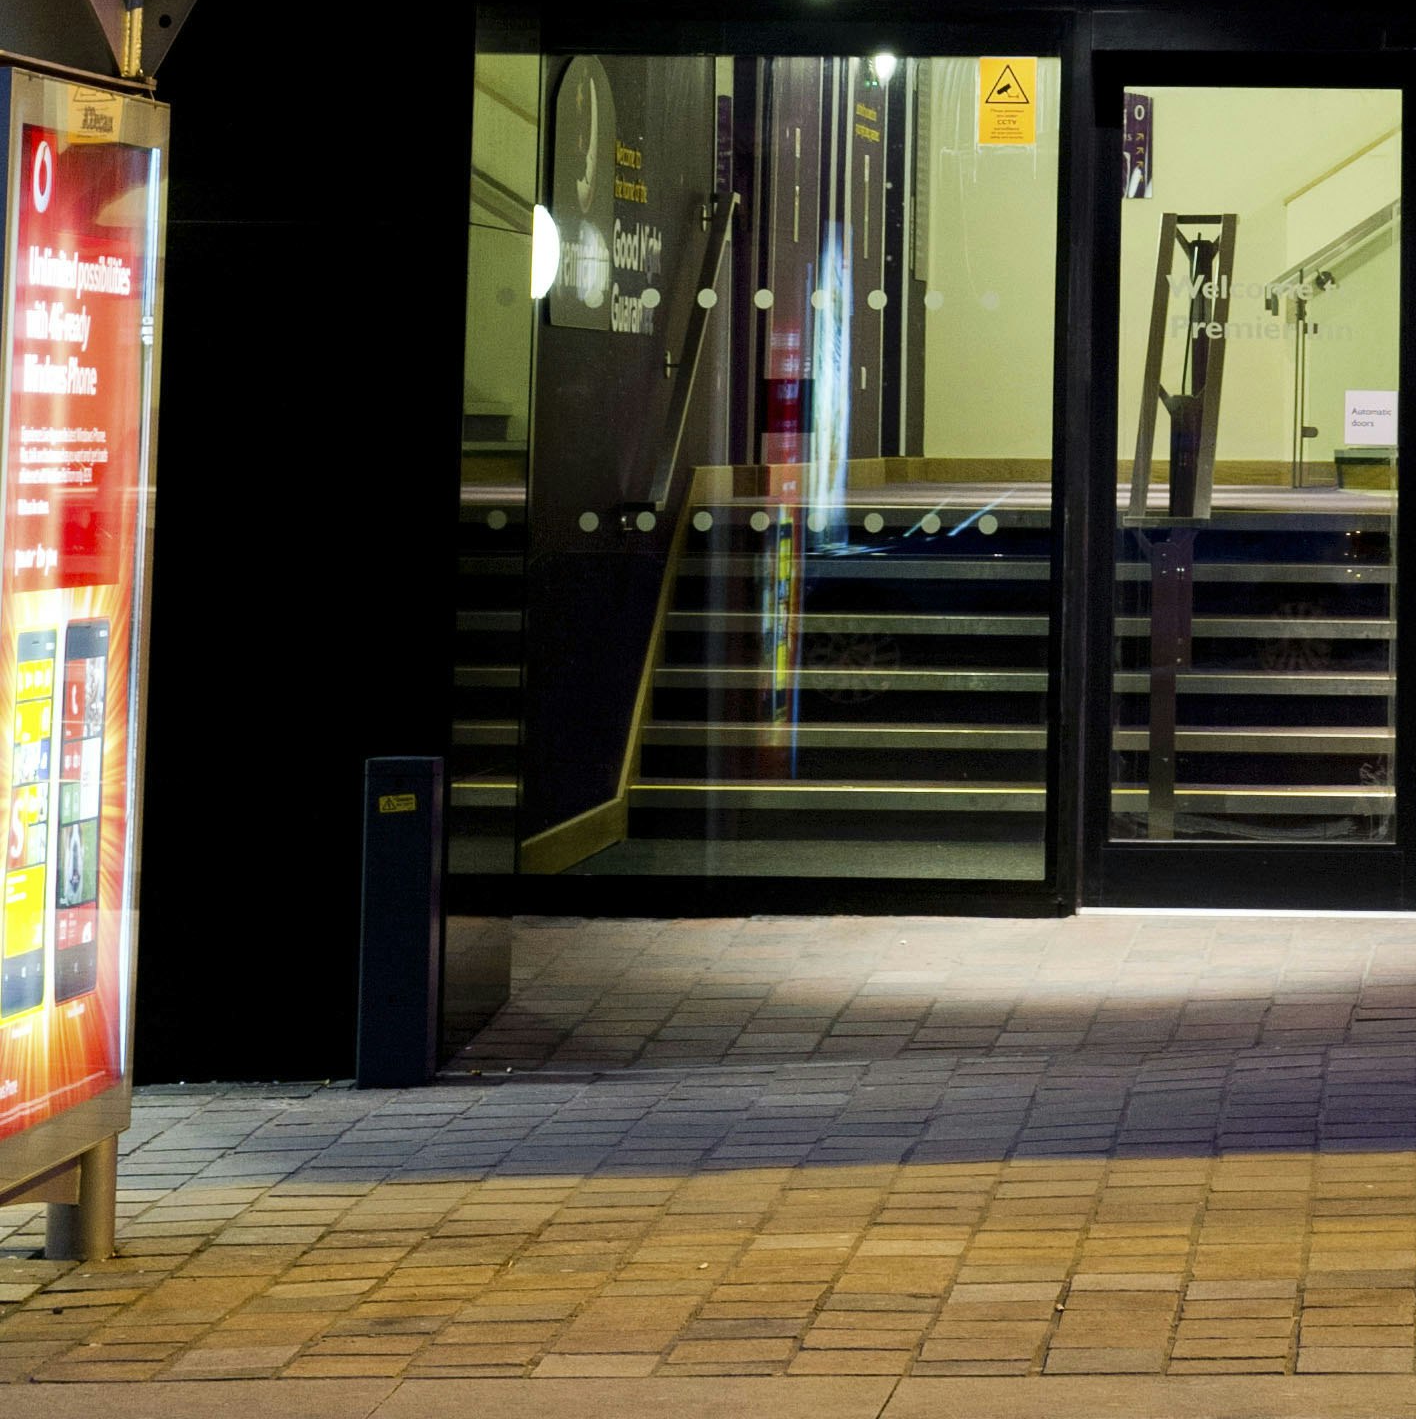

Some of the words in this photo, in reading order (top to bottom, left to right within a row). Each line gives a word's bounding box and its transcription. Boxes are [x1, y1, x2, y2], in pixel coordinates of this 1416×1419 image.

[613, 218, 639, 272] Good
[76, 256, 131, 299] possibilities
[1166, 274, 1313, 300] Welcome
[1170, 315, 1297, 340] Premier
[1351, 408, 1392, 416] Automatic
